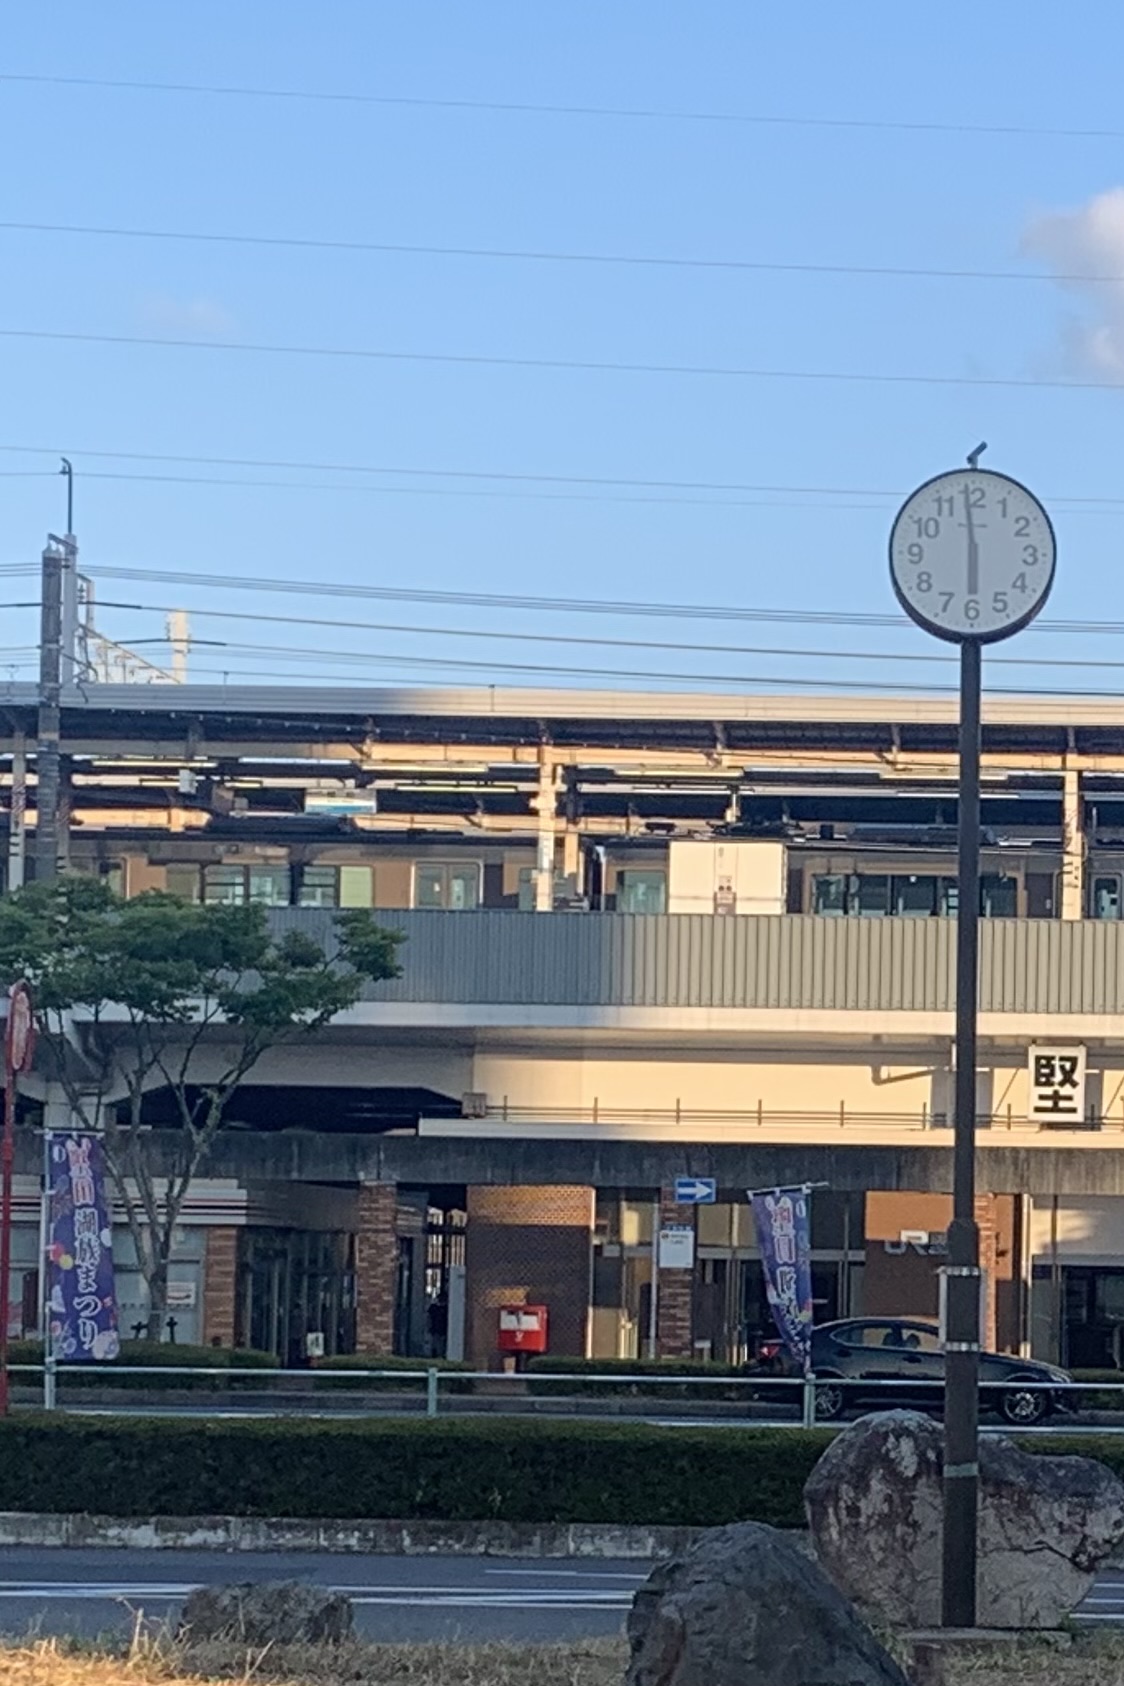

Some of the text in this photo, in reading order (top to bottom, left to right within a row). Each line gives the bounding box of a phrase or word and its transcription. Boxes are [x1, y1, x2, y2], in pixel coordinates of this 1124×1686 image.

[932, 495, 954, 517] 11
[997, 497, 1008, 518] 1
[914, 517, 940, 539] 10
[1014, 516, 1031, 538] 2
[907, 543, 923, 565] 9
[1022, 545, 1039, 567] 3
[916, 571, 933, 593] 8
[1012, 572, 1028, 594] 4
[938, 592, 955, 613] 7
[964, 599, 980, 621] 6
[992, 592, 1008, 613] 5
